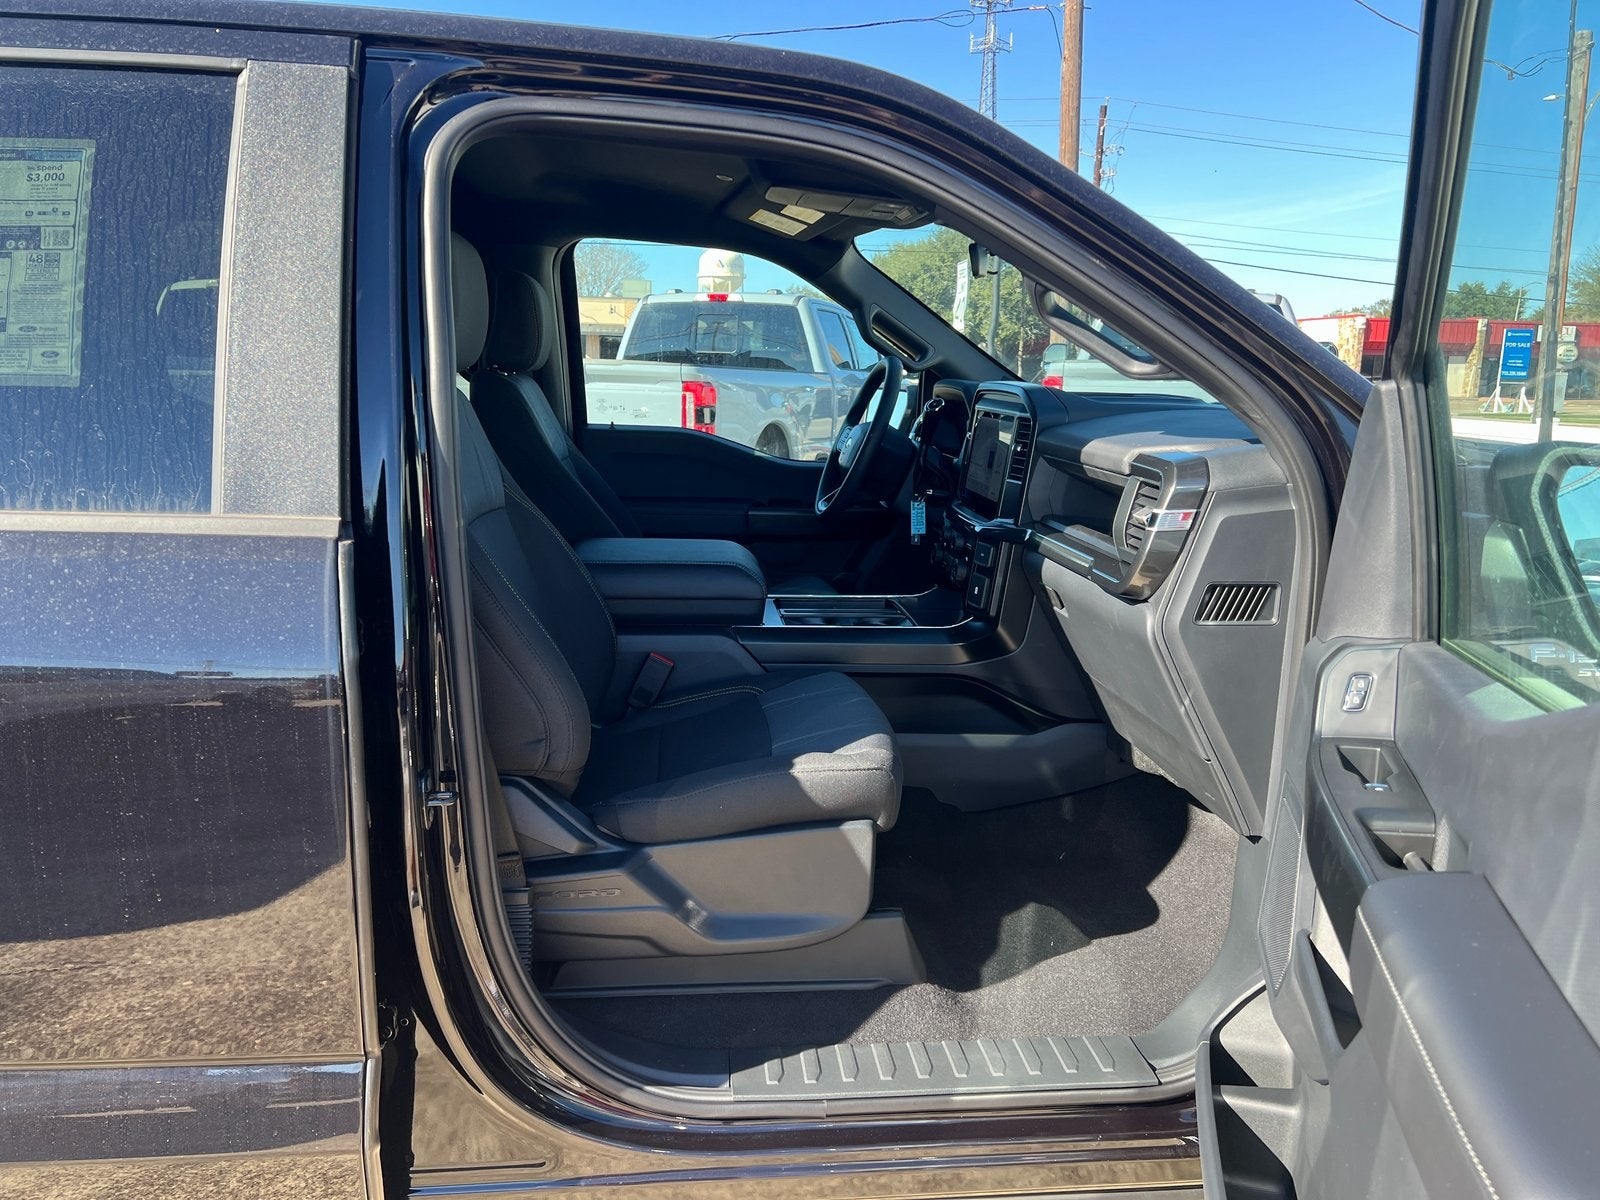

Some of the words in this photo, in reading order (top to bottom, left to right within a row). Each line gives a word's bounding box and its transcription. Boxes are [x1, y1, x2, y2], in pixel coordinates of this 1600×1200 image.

[37, 164, 63, 172] spend
[26, 172, 65, 183] $3,000
[29, 254, 43, 263] 48
[534, 887, 621, 899] FORD
